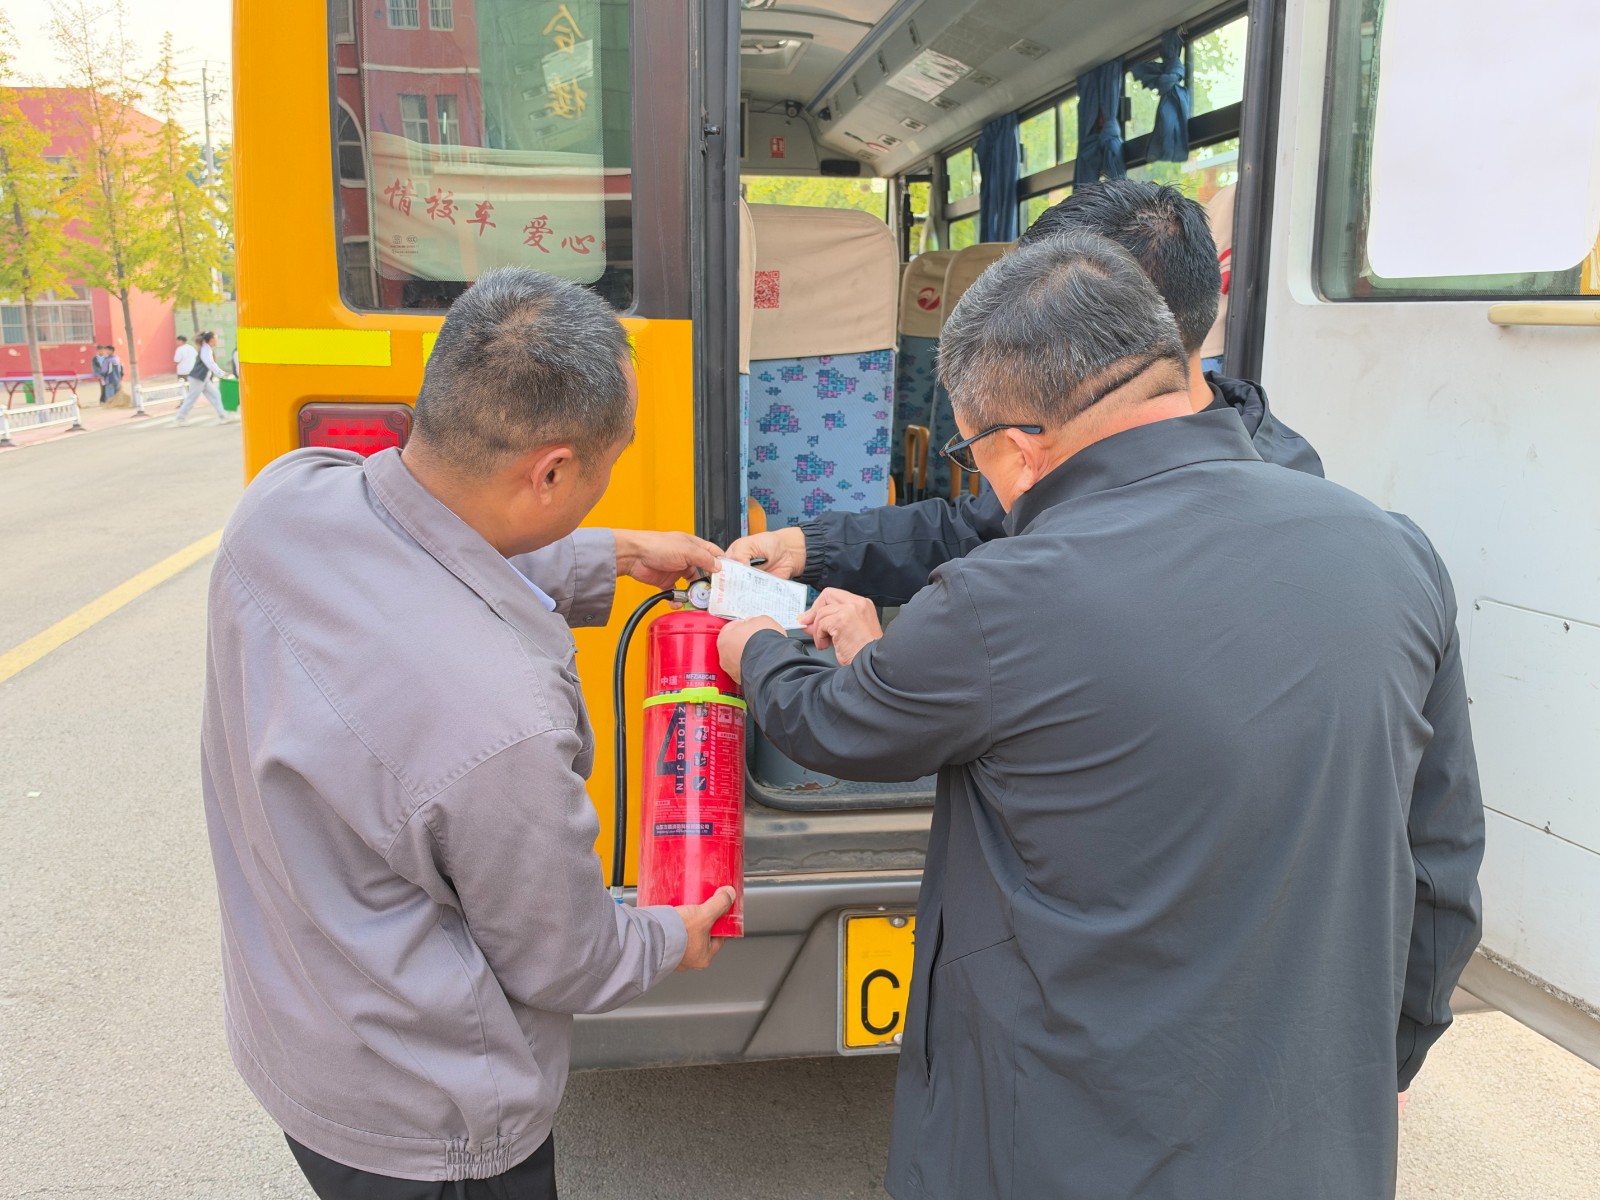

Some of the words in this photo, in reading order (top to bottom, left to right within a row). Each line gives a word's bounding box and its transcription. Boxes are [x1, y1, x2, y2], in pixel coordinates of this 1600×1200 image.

[522, 214, 596, 254] 爱心
[656, 702, 691, 776] 4
[861, 969, 900, 1036] C
